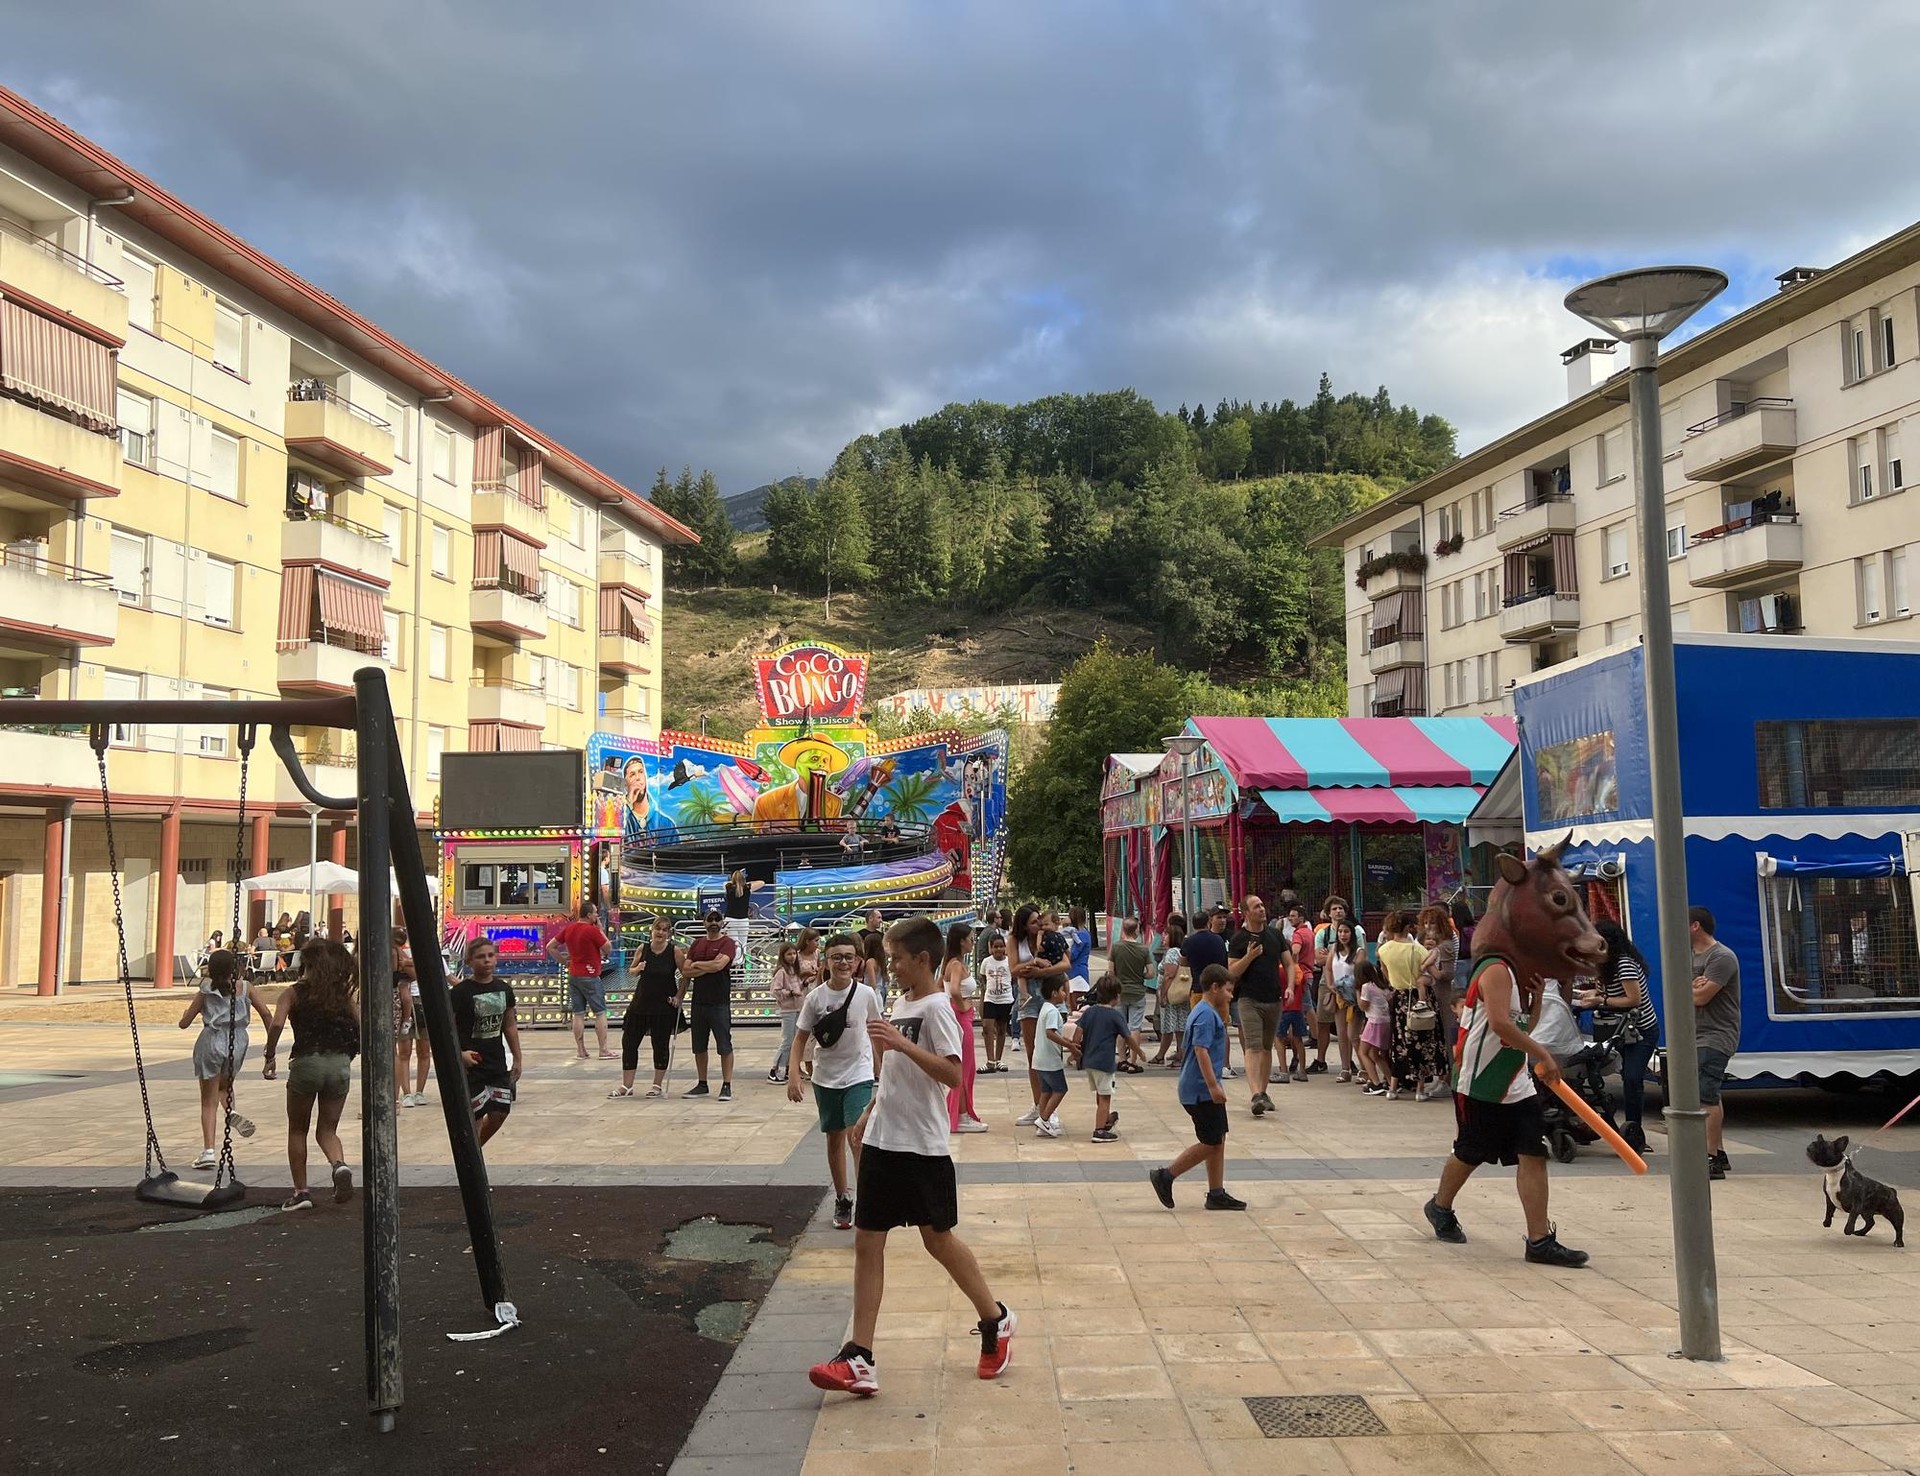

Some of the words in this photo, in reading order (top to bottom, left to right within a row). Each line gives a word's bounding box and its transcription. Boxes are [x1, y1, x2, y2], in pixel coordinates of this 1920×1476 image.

[767, 672, 858, 716] BONGO
[775, 717, 804, 726] Show
[819, 716, 850, 725] Disco
